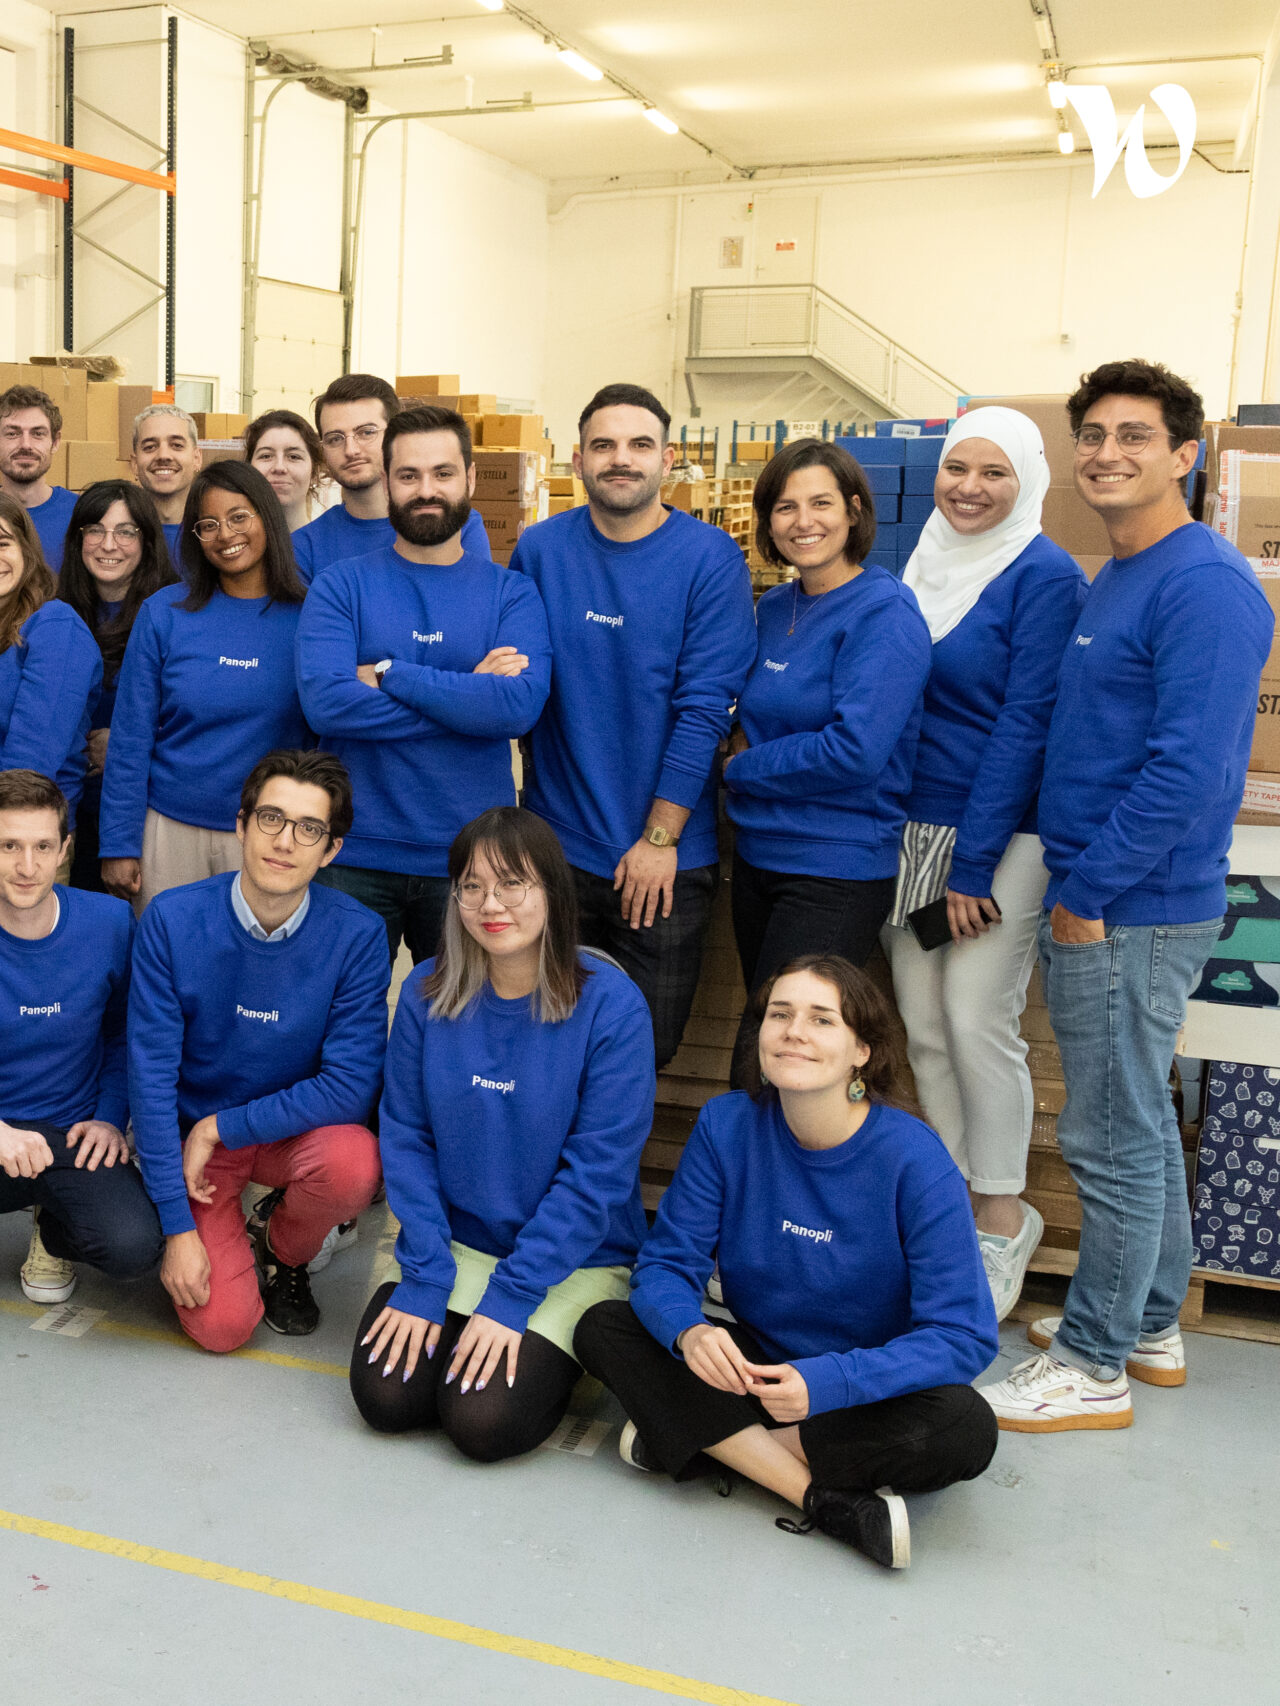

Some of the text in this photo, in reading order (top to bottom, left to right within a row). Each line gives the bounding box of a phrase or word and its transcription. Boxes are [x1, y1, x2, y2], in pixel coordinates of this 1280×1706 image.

[586, 610, 624, 628] Panopli
[219, 655, 259, 670] Panopli
[1257, 693, 1280, 715] ST
[19, 1002, 61, 1017] Panopli
[236, 1004, 279, 1023] Panopli
[471, 1074, 516, 1094] Panopli
[782, 1219, 833, 1244] Panopli
